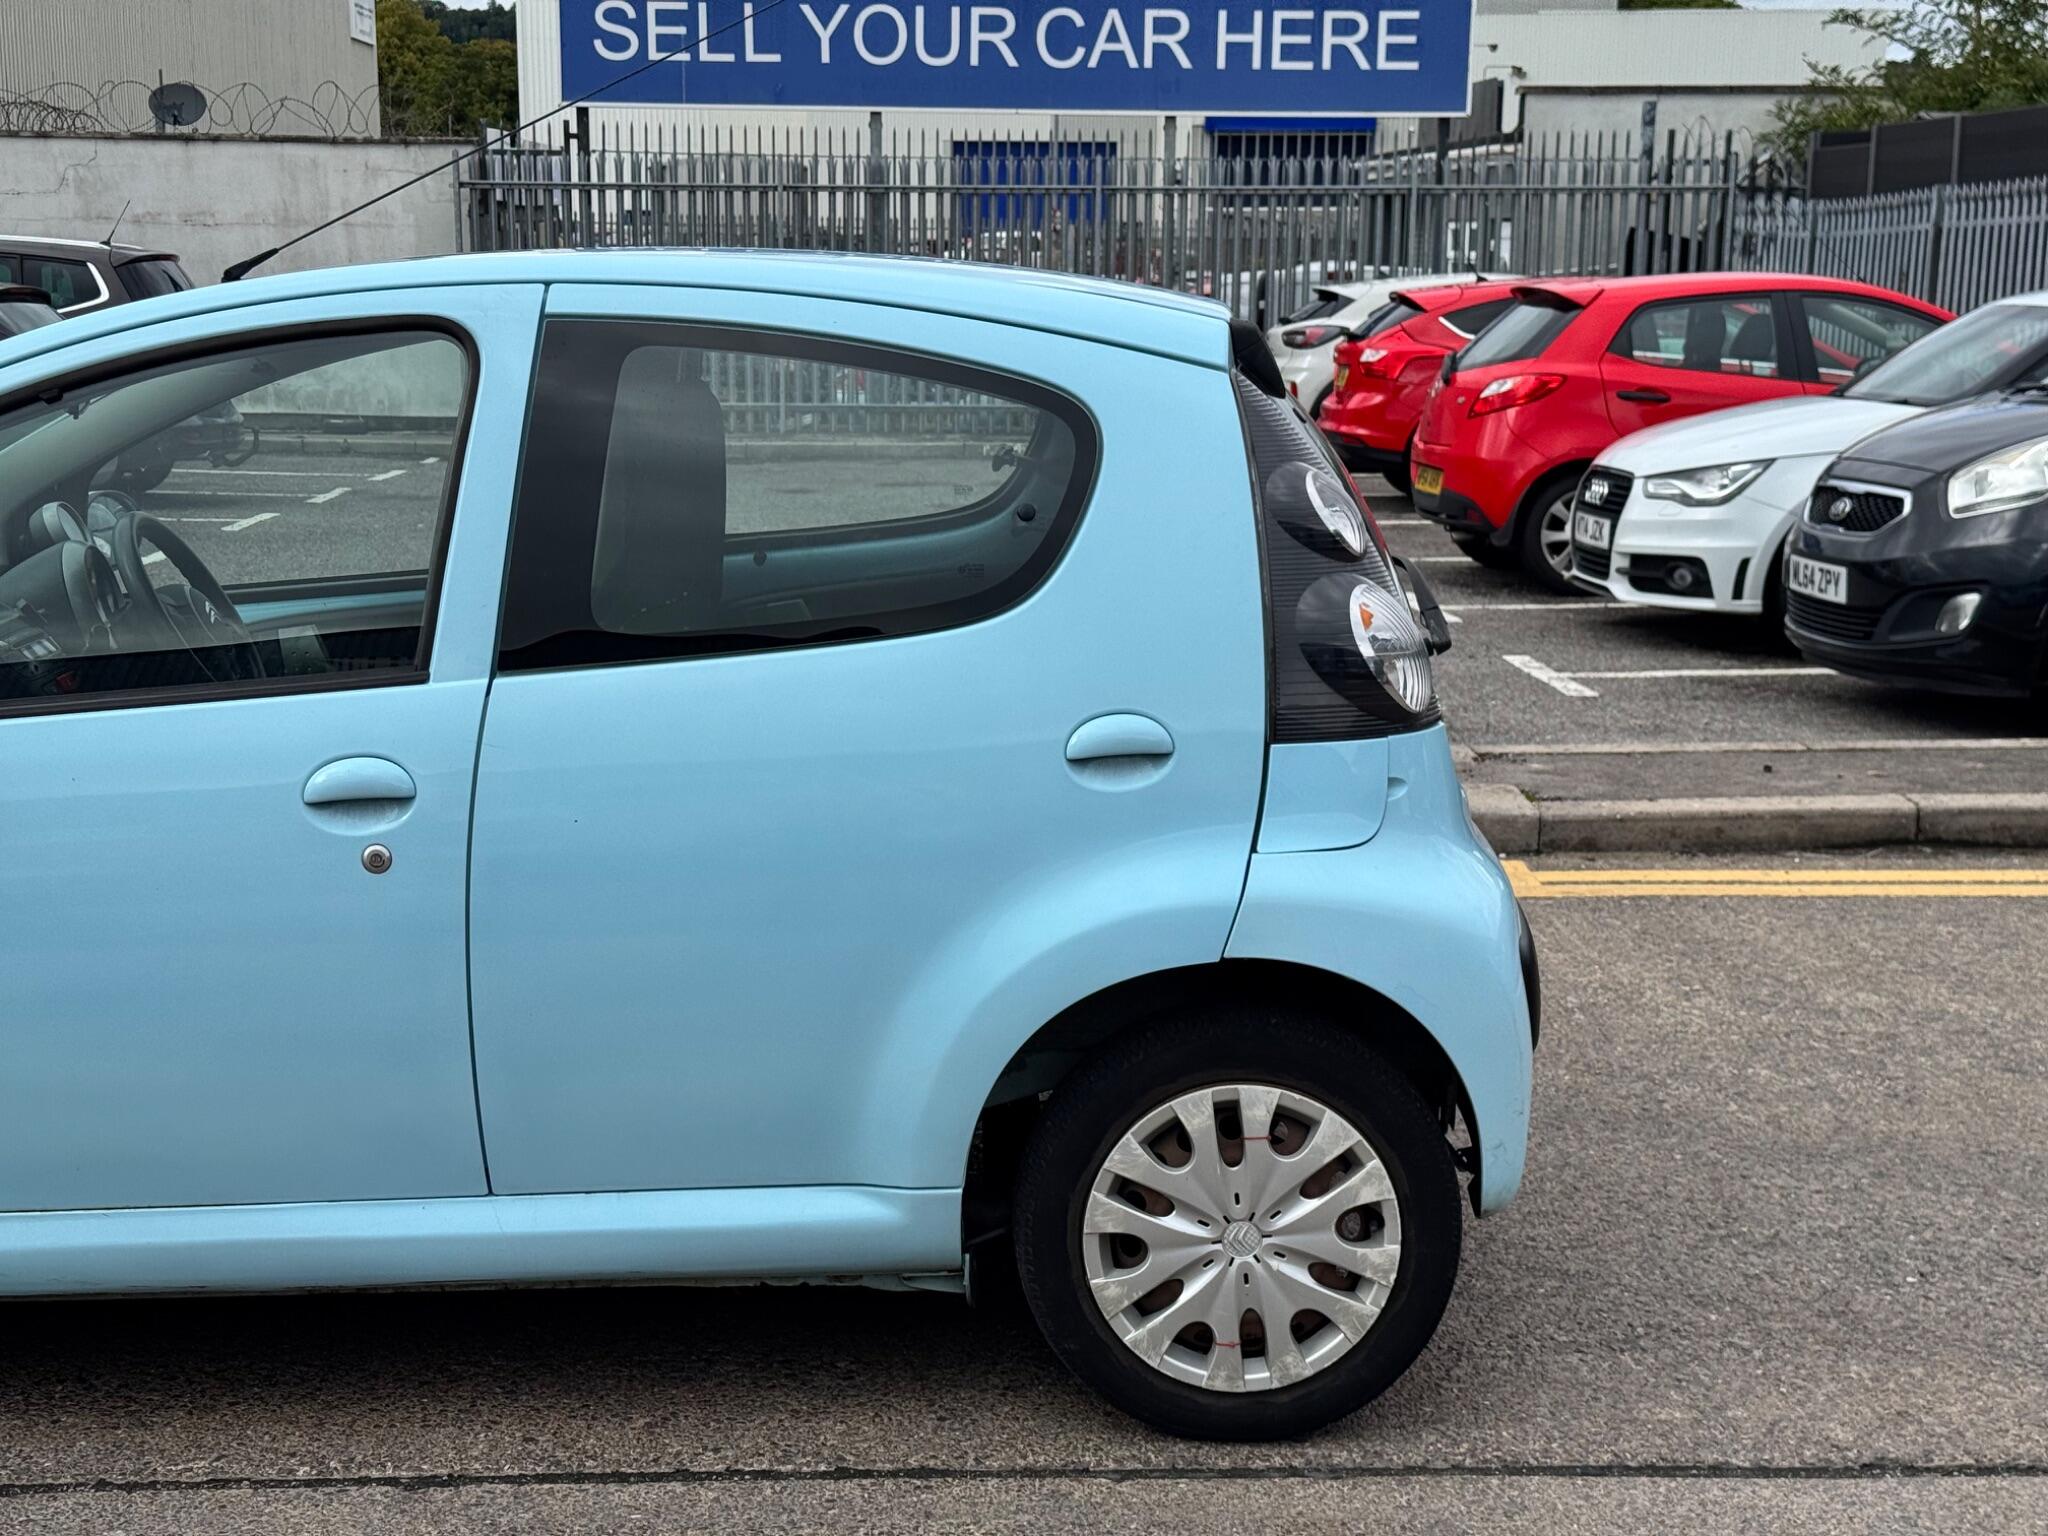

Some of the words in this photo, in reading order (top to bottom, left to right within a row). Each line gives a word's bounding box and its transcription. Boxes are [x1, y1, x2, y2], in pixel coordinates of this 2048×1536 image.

[593, 0, 782, 62] SELL
[799, 3, 1019, 67] YOUR
[1036, 7, 1193, 69] CAR
[1216, 9, 1420, 70] HERE
[1817, 566, 1841, 597] ZPY
